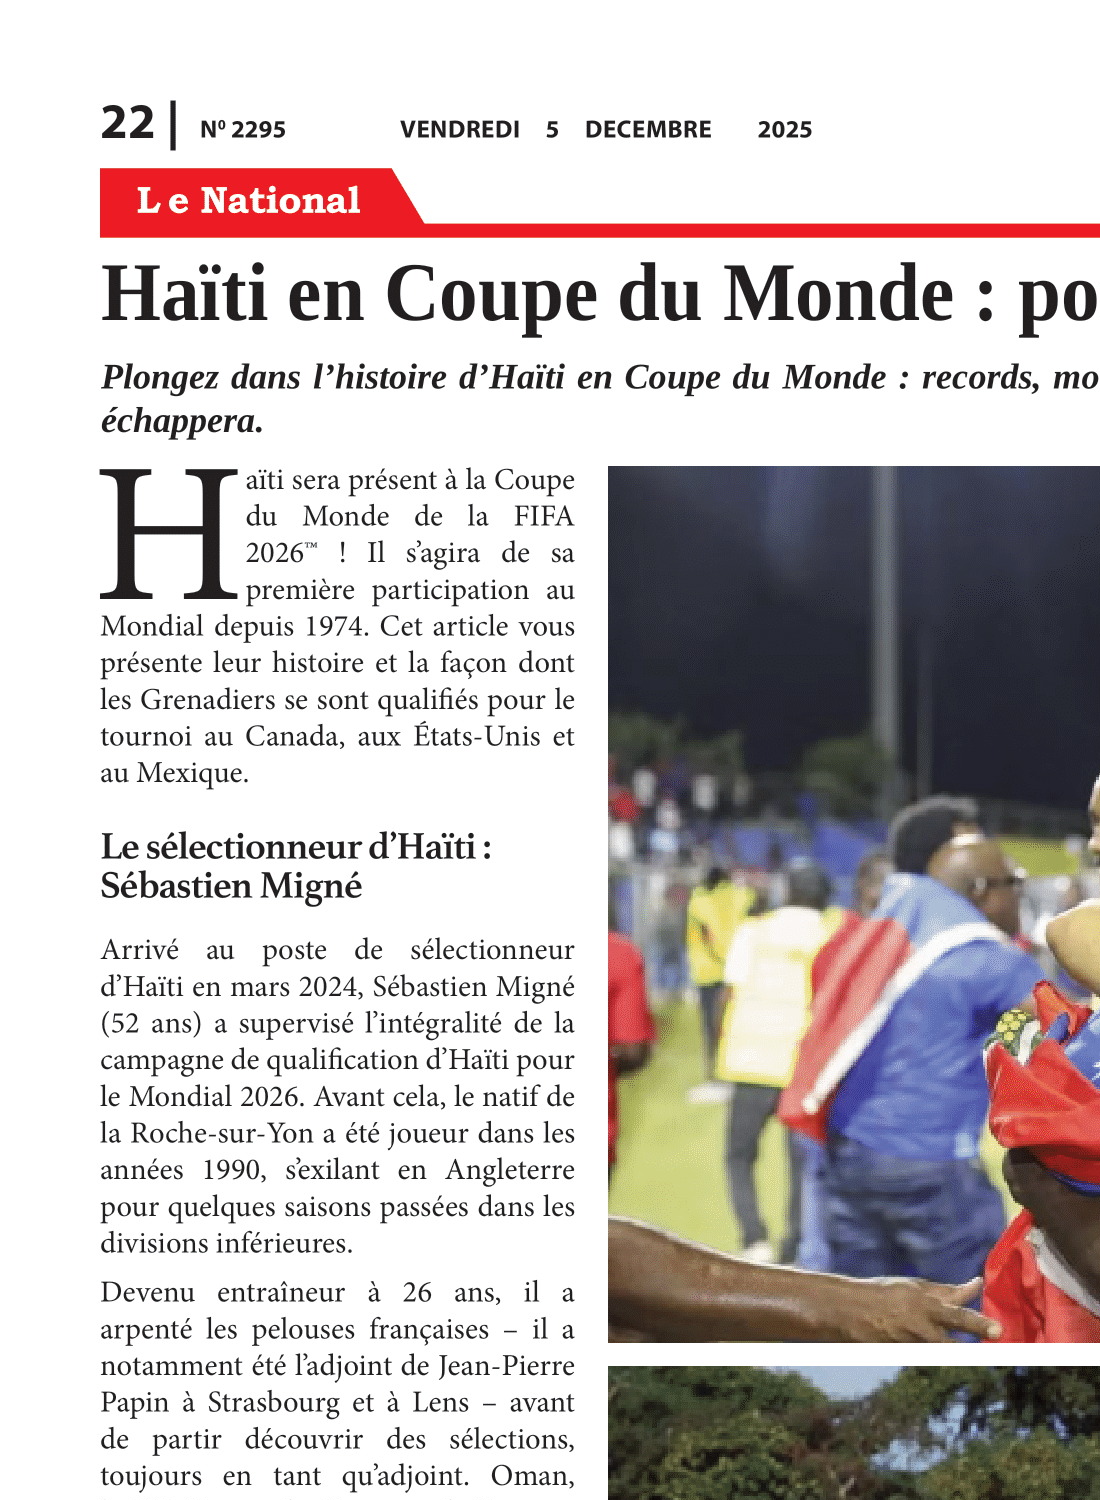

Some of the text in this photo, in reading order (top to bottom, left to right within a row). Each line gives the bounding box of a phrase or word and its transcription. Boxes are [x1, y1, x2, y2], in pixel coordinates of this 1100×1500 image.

[102, 105, 153, 138] 22
[232, 121, 285, 138] 2295
[400, 120, 812, 138] VENDREDI 5 DECEMBRE 2025
[201, 186, 360, 213] National
[102, 262, 267, 321] Haïti
[290, 281, 364, 321] en
[388, 265, 596, 338] Coupe
[620, 262, 701, 321] du
[724, 262, 952, 321] Monde
[101, 363, 219, 396] Plongez
[231, 363, 300, 389] dans
[314, 363, 446, 389] l’histoire
[459, 363, 565, 389] d’Haïti
[578, 371, 611, 389] en
[626, 364, 720, 396] Coupe
[733, 363, 769, 389] du
[782, 363, 886, 389] Monde
[923, 363, 1039, 394] records,
[102, 407, 262, 440] échappera.
[293, 475, 340, 489] sera
[349, 468, 437, 496] présent
[446, 468, 458, 489] à
[466, 467, 486, 489] la
[495, 469, 574, 496] Coupe
[247, 504, 574, 526] du Monde de la FIFA
[368, 540, 385, 562] Il
[407, 540, 480, 570] s’agira
[502, 540, 529, 562] de
[552, 548, 575, 562] sa
[102, 833, 139, 859] Le
[147, 831, 362, 859] sélectionneur
[369, 831, 476, 859] d’Haïti
[101, 870, 362, 907] Sébastien Migné
[101, 937, 575, 966] Arrivé au poste de sélectionneur
